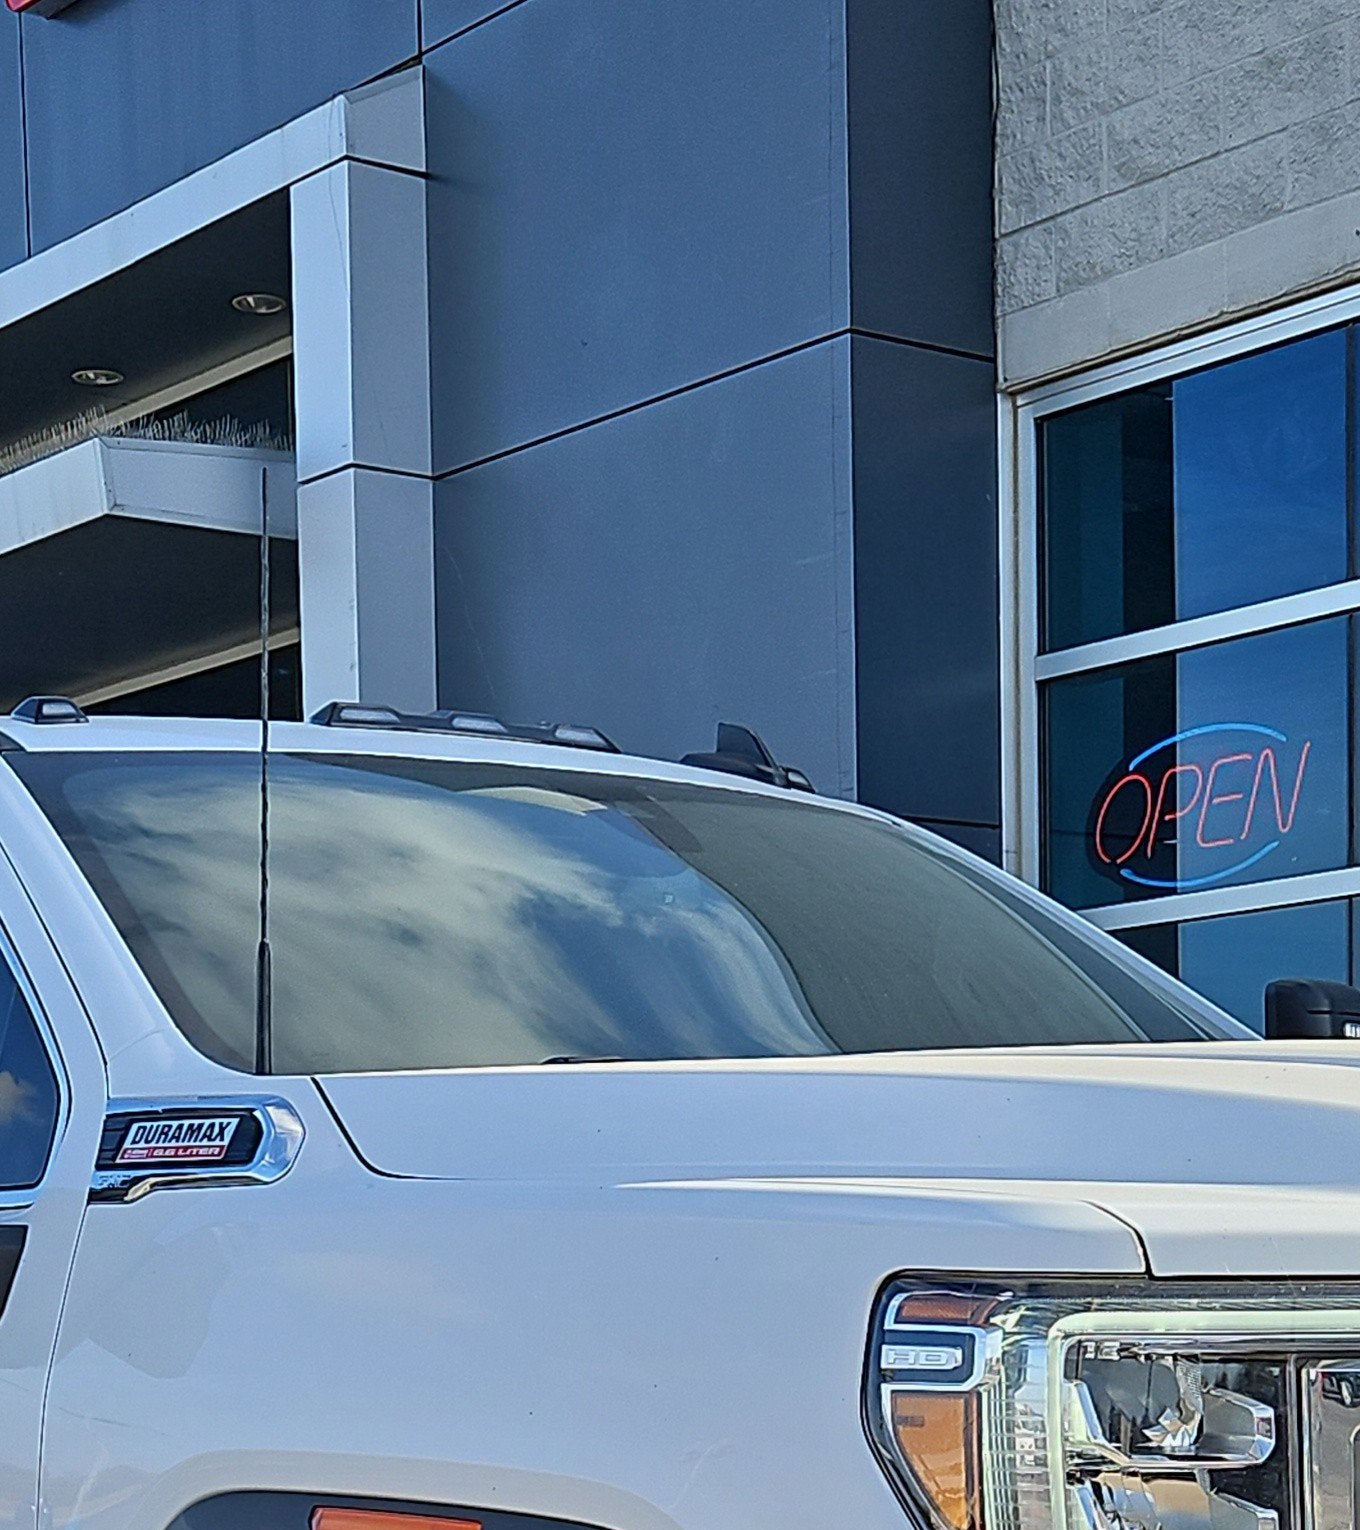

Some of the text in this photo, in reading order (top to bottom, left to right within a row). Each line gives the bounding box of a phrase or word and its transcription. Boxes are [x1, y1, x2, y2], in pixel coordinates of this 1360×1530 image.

[1095, 741, 1312, 864] OPEN
[129, 1121, 232, 1146] DURAMAX
[177, 1146, 221, 1156] LITER
[887, 1348, 949, 1366] HD
